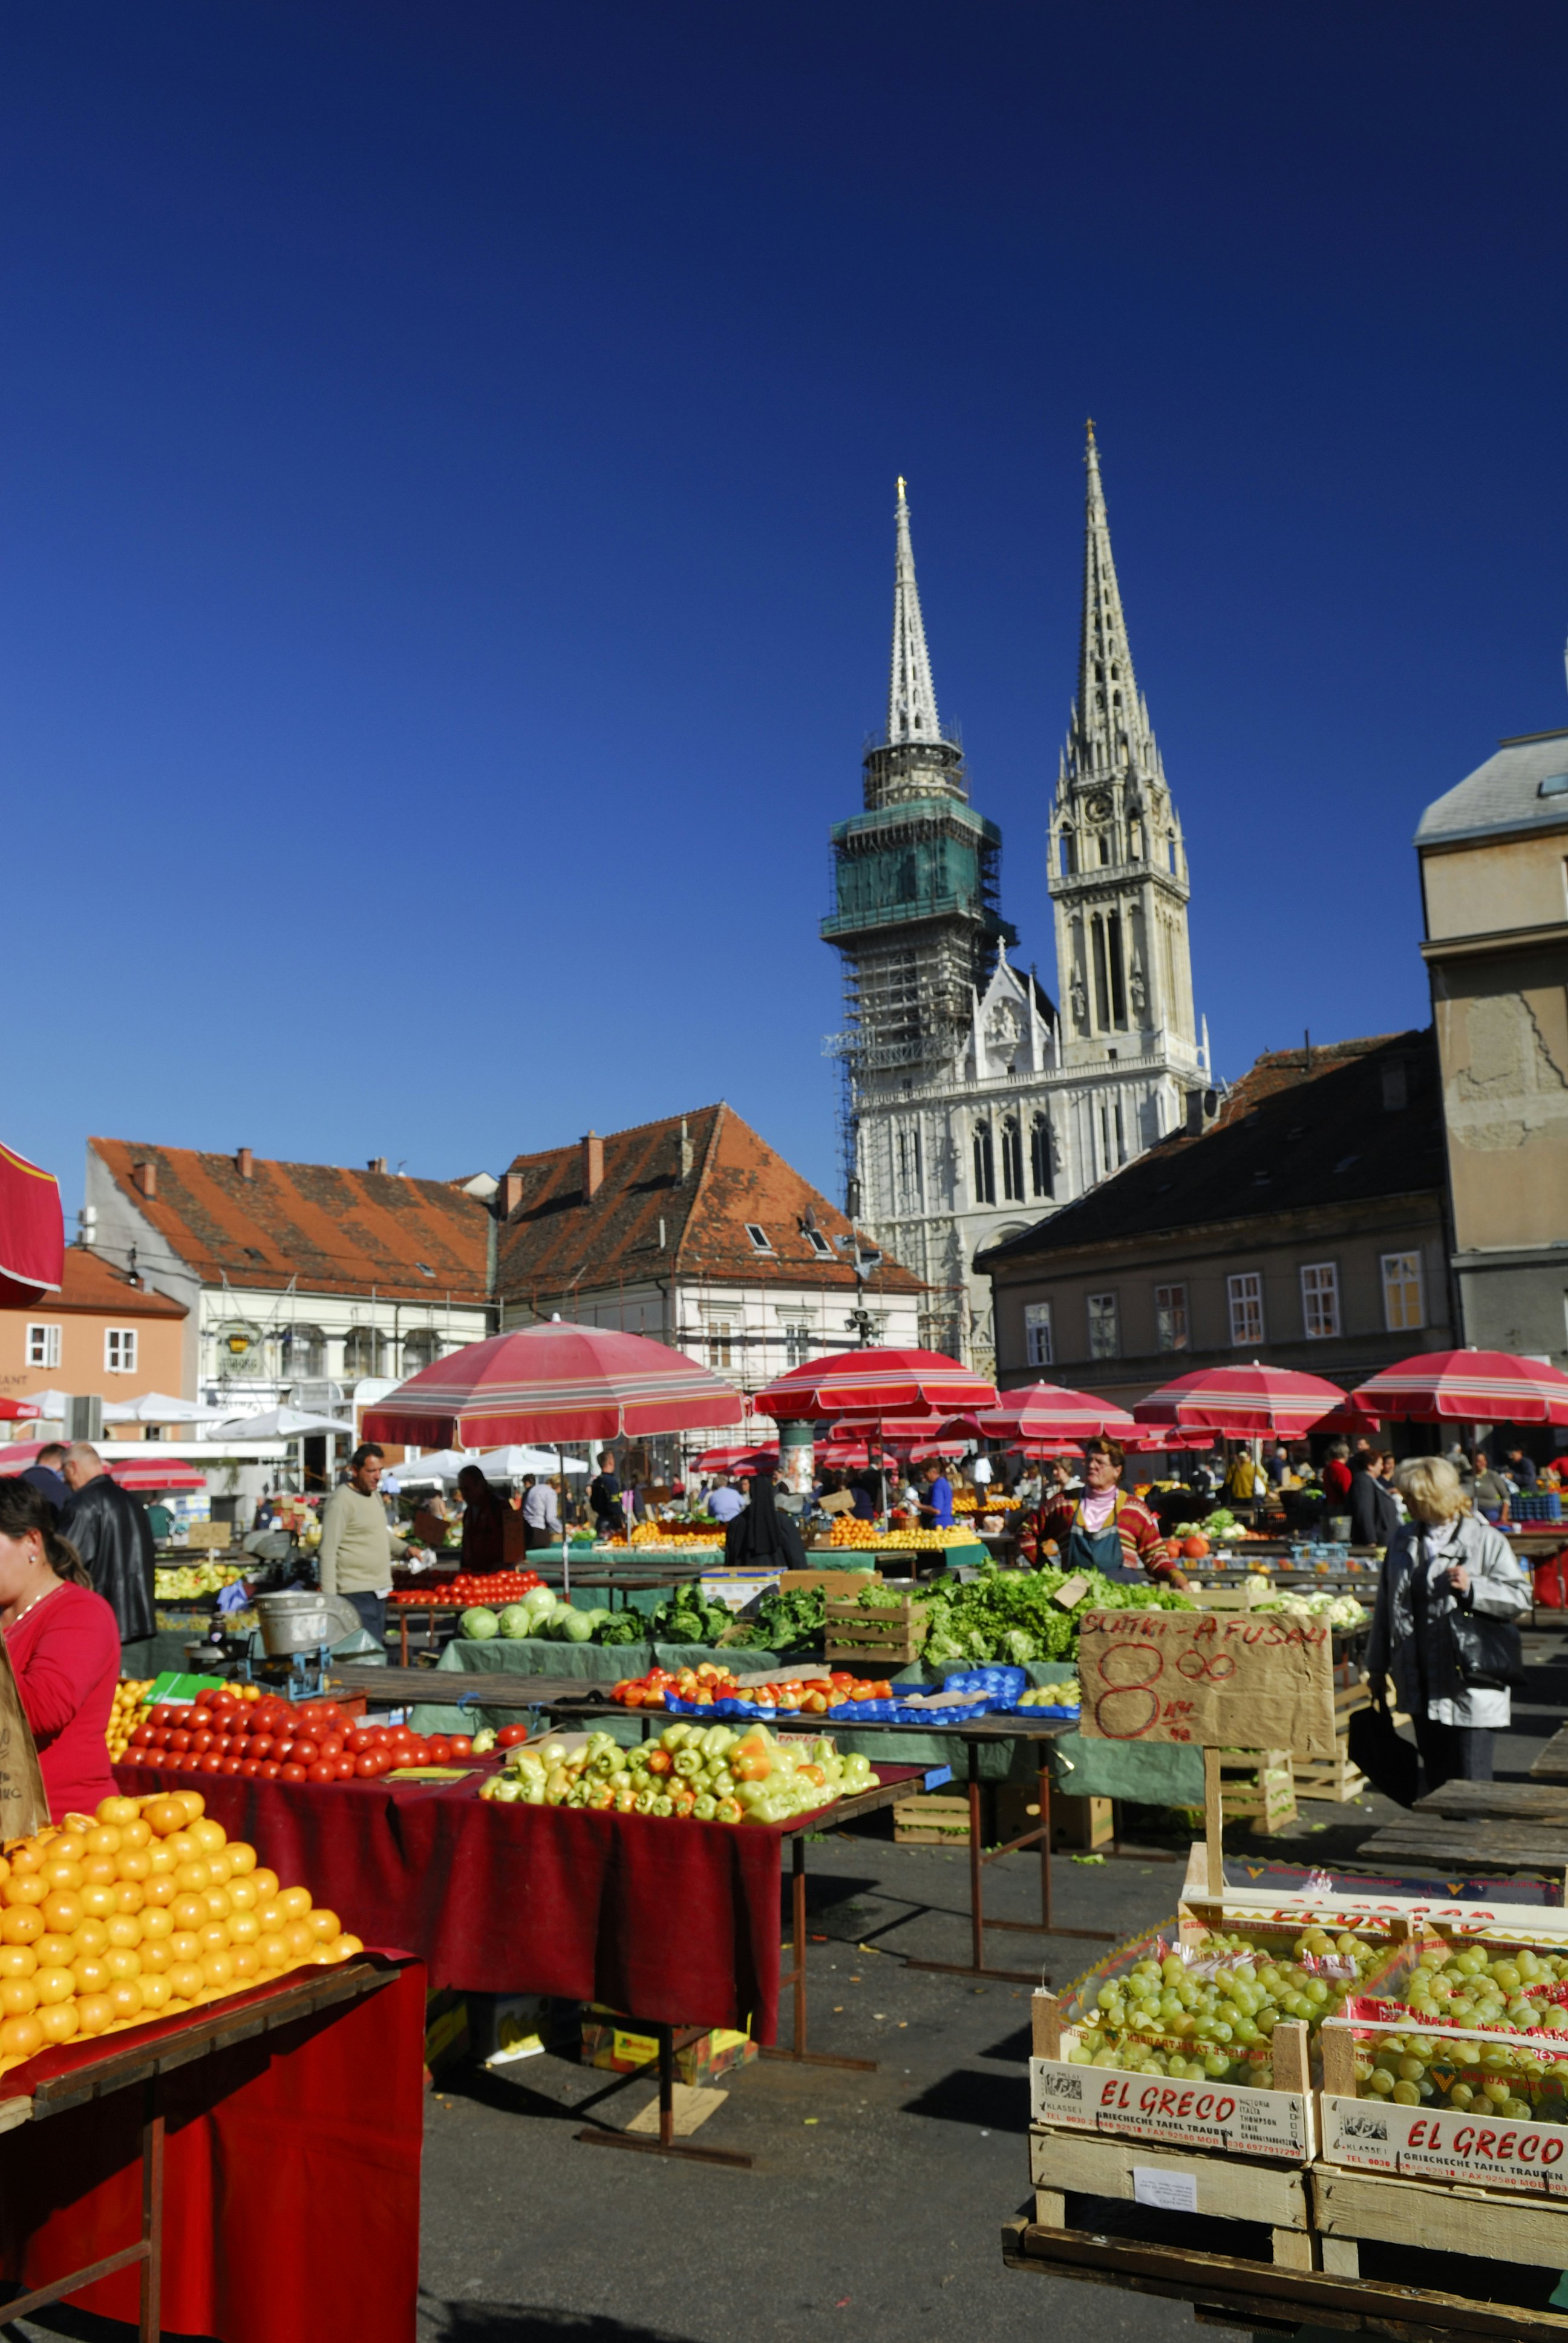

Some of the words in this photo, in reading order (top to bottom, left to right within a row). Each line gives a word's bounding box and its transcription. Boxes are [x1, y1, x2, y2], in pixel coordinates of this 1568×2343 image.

[1096, 1642, 1164, 1740] 8
[1100, 2079, 1131, 2109] EL
[1140, 2086, 1236, 2123] GRECO
[1047, 2103, 1077, 2114] KLASSE
[1156, 2120, 1184, 2131] TAFEL
[1240, 2114, 1277, 2126] THOMPSON
[1407, 2119, 1442, 2150] EL
[1452, 2126, 1564, 2164] GRECO
[1347, 2144, 1381, 2155] KLASSE
[1368, 2158, 1391, 2168] 0030
[1485, 2175, 1517, 2185] 92580
[1474, 2161, 1506, 2174] TAFEL
